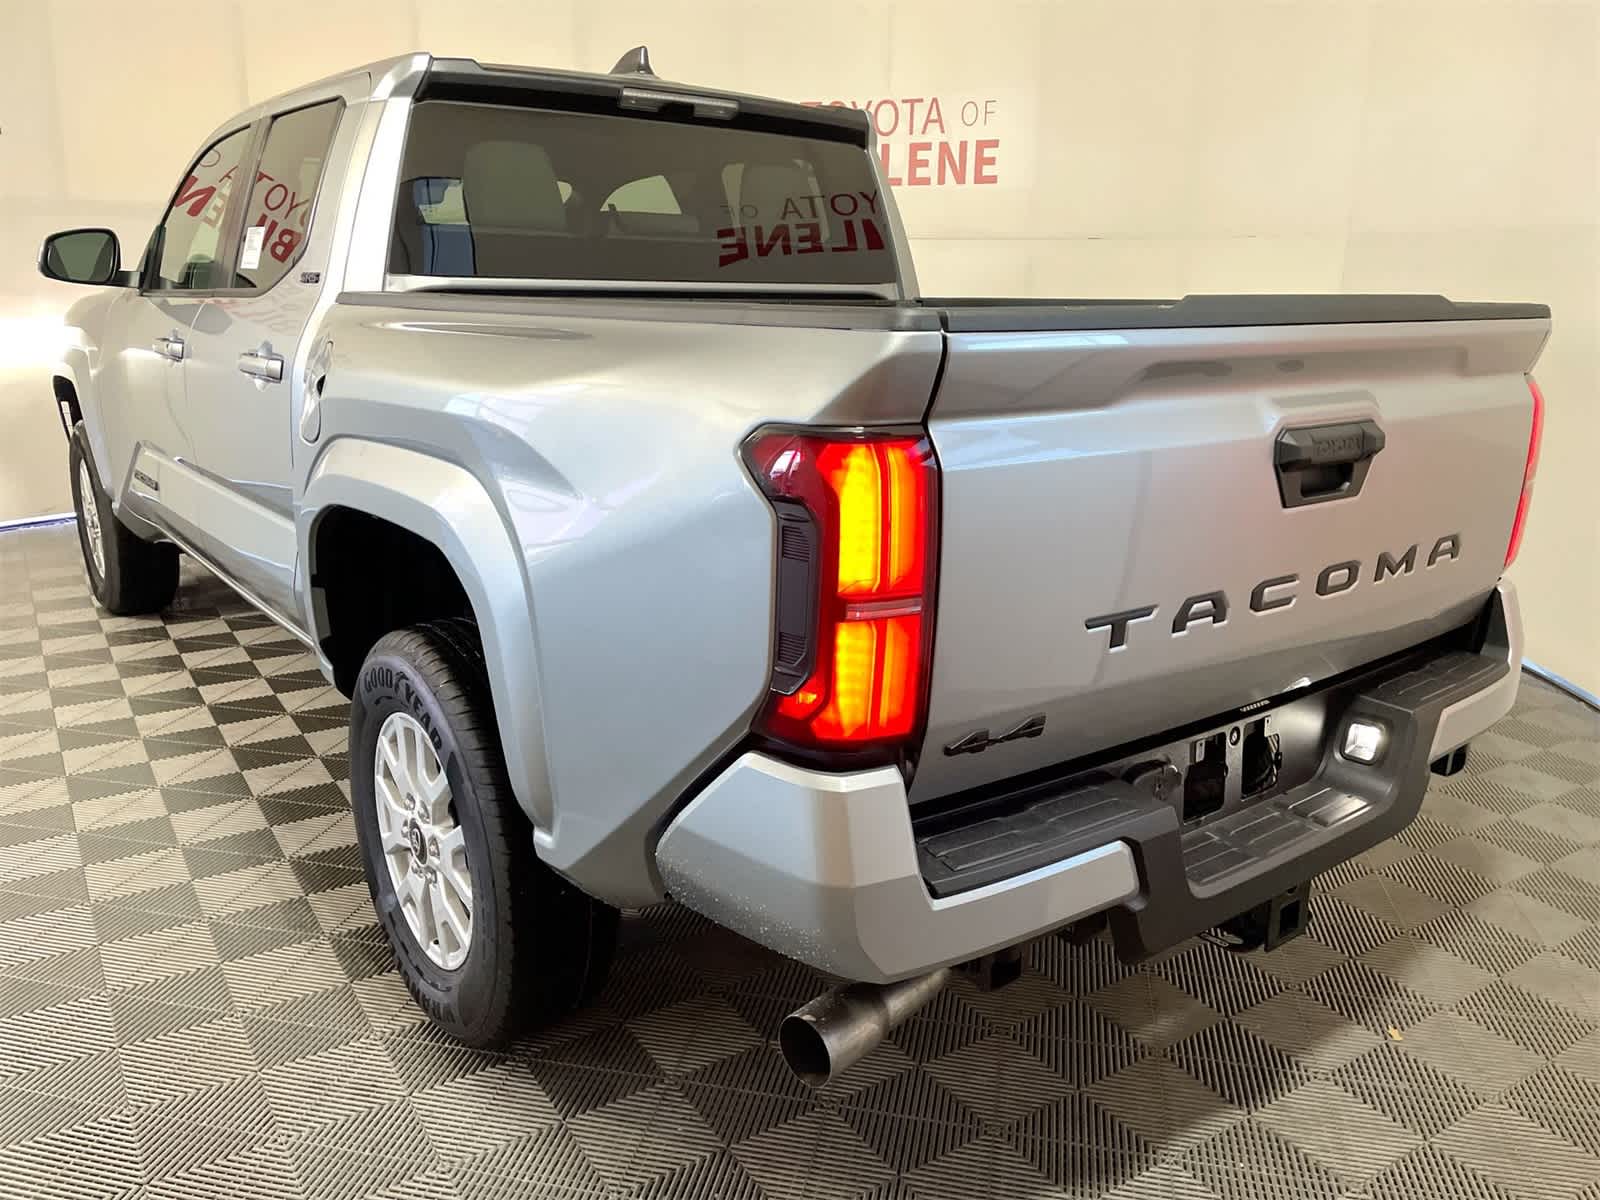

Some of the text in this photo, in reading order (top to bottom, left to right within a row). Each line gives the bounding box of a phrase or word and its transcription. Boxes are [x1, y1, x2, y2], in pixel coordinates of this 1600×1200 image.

[961, 100, 996, 127] OF
[880, 139, 1000, 186] LENE
[1084, 533, 1462, 652] TACOMA
